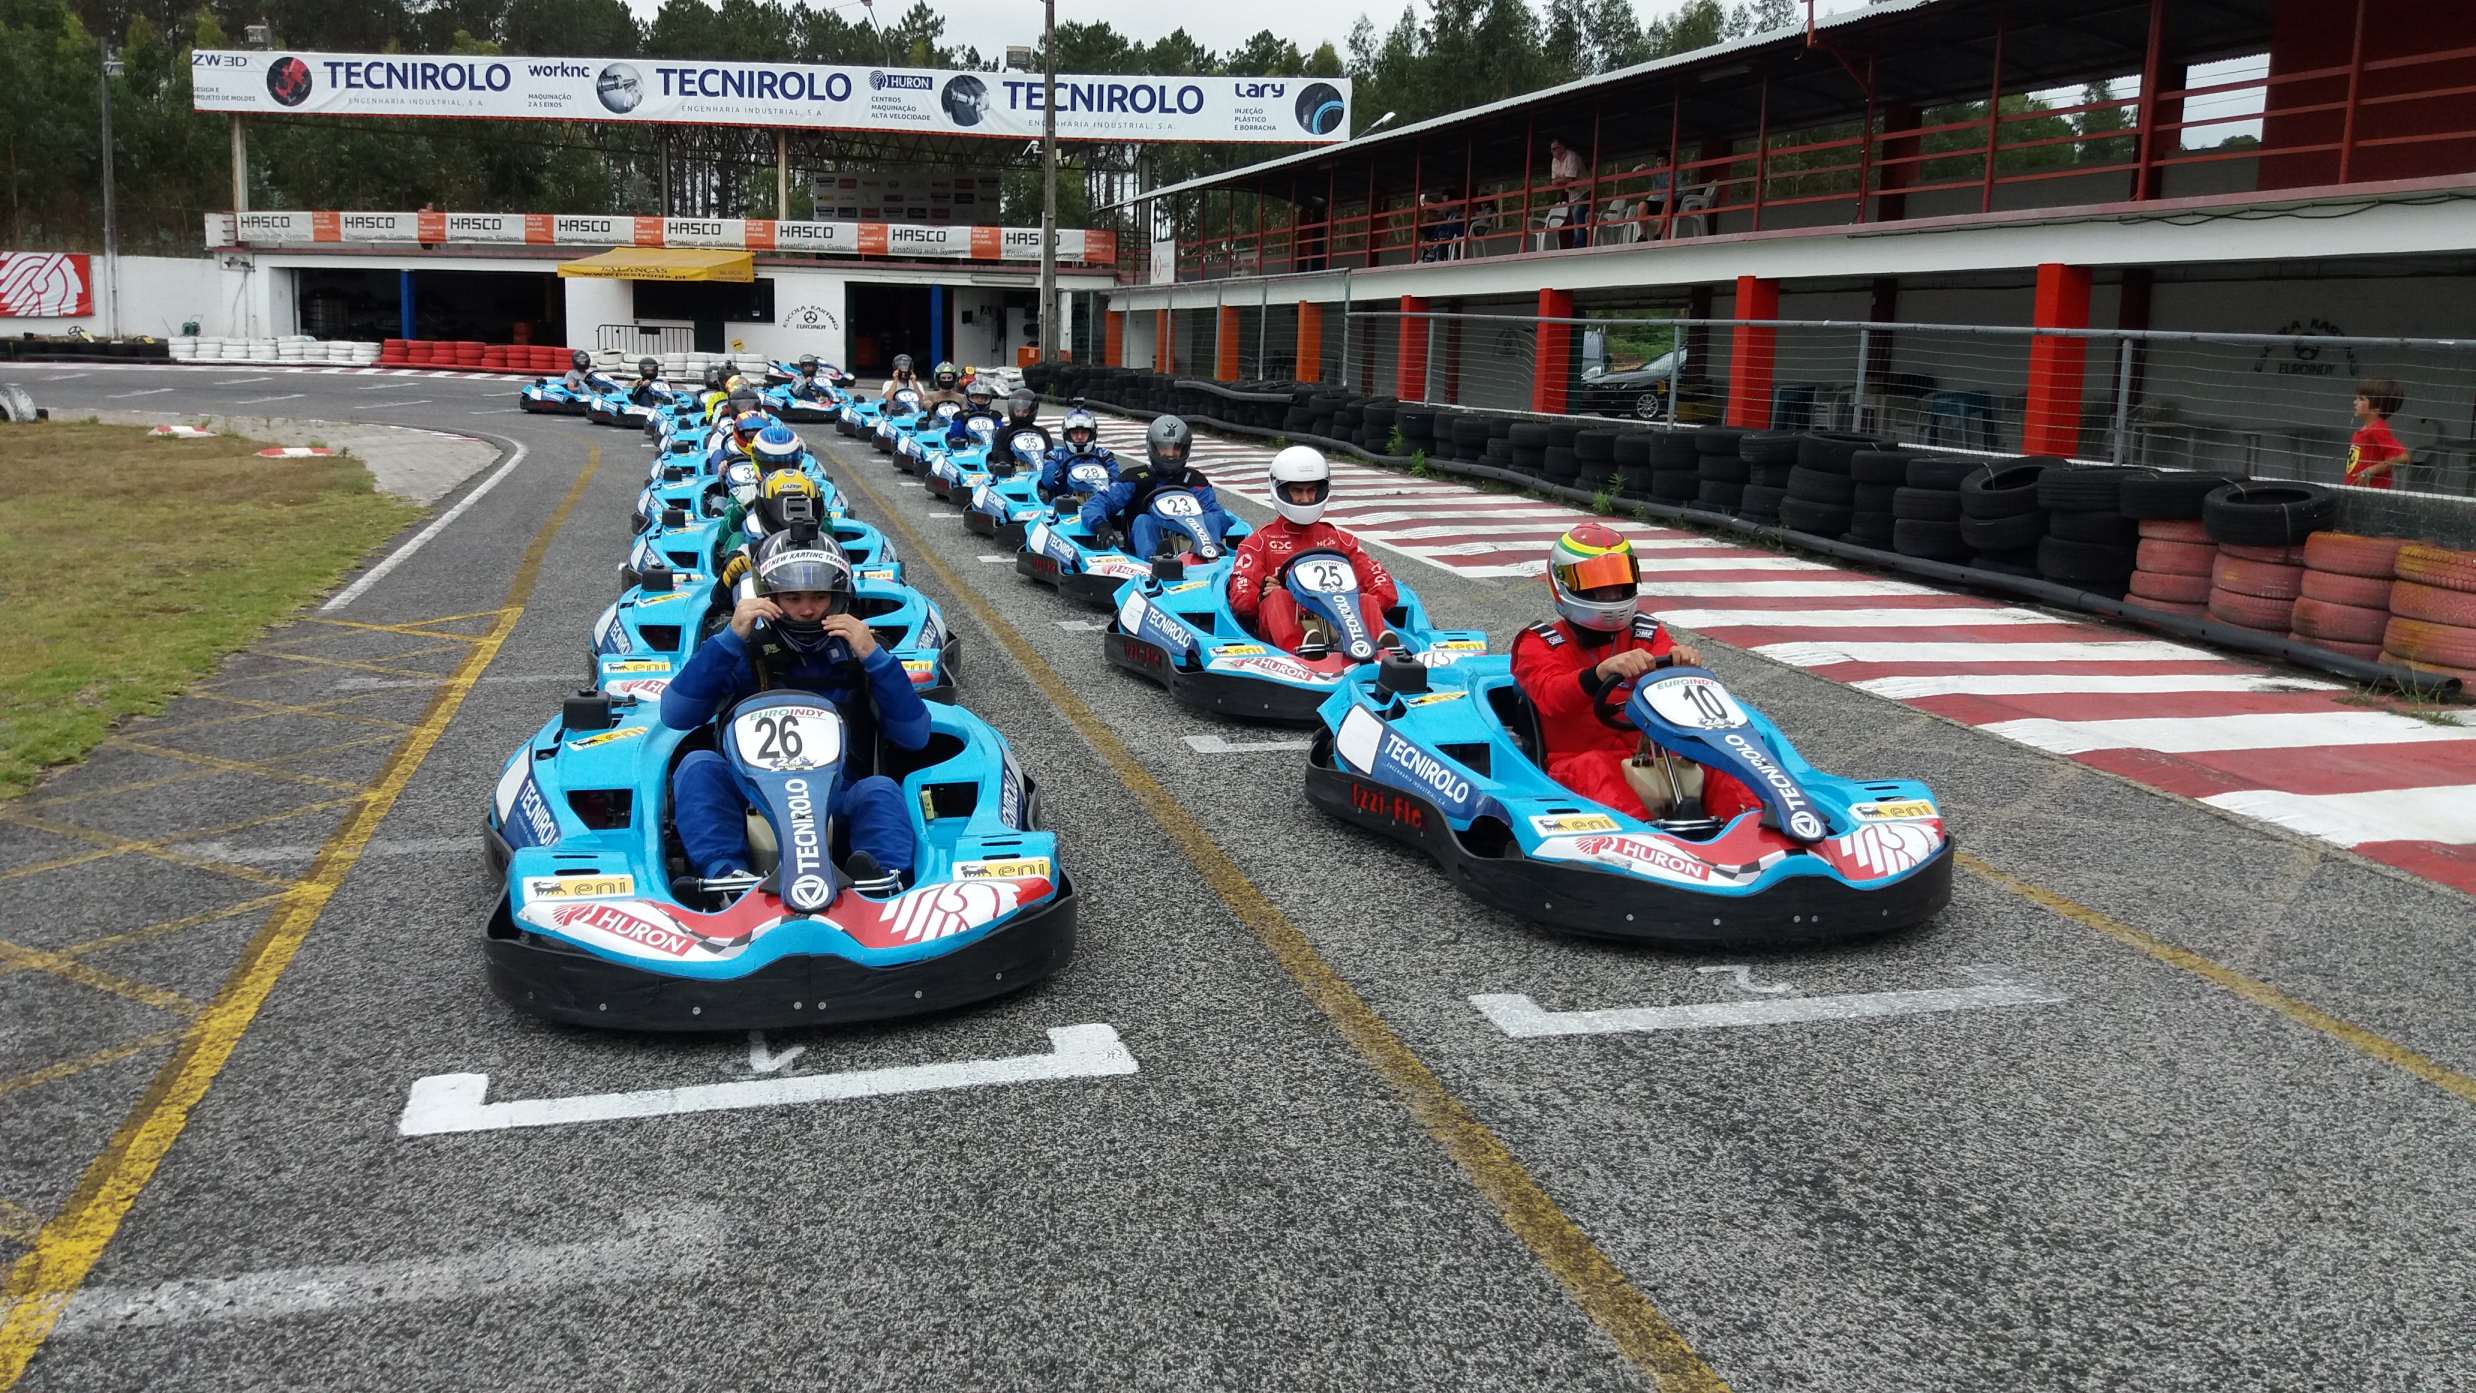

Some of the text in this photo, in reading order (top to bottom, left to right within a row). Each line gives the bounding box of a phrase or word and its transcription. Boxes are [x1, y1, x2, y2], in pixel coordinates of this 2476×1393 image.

[323, 61, 512, 92] TECNIROLO
[528, 61, 591, 78] worknc
[656, 68, 852, 102] TECNIROLO
[890, 77, 930, 89] HURON
[871, 96, 902, 104] CENTROS
[1002, 81, 1204, 115] TECNIROLO
[681, 105, 741, 113] ENGENHARIA
[871, 104, 917, 112] MAQUINAÇÃO
[1234, 107, 1264, 115] INJEÇÃO
[889, 113, 931, 121] VELOCIDADE
[1234, 115, 1267, 123] PLÁSTICO
[240, 216, 291, 229] HASCO
[344, 216, 396, 229] HASCO
[450, 217, 502, 230] HASCO
[558, 219, 611, 233] HASCO
[668, 222, 722, 236] HASCO
[780, 225, 834, 239] HASCO
[892, 228, 947, 243] HASCO
[1006, 232, 1060, 246] HAS
[1023, 437, 1038, 449] 35
[1081, 467, 1100, 478] 28
[1167, 497, 1192, 513] 23
[788, 548, 823, 562] KARTING
[1313, 565, 1344, 588] 25
[1146, 606, 1192, 649] TECNIROLO
[1259, 658, 1310, 681] HURON
[1683, 685, 1728, 720] 10
[750, 707, 826, 721] EUROINDY
[754, 714, 803, 760] 26
[1384, 733, 1470, 804] TECNIROLO
[1724, 733, 1808, 812] TECNIROLO
[519, 778, 561, 847] TECNIROL
[1889, 803, 1934, 818] eni
[784, 778, 820, 874] TECNIROLO
[1570, 817, 1613, 832] eni
[1621, 839, 1703, 878] HURON
[998, 861, 1046, 877] eni
[573, 878, 627, 897] eni
[595, 909, 689, 954] HURON
